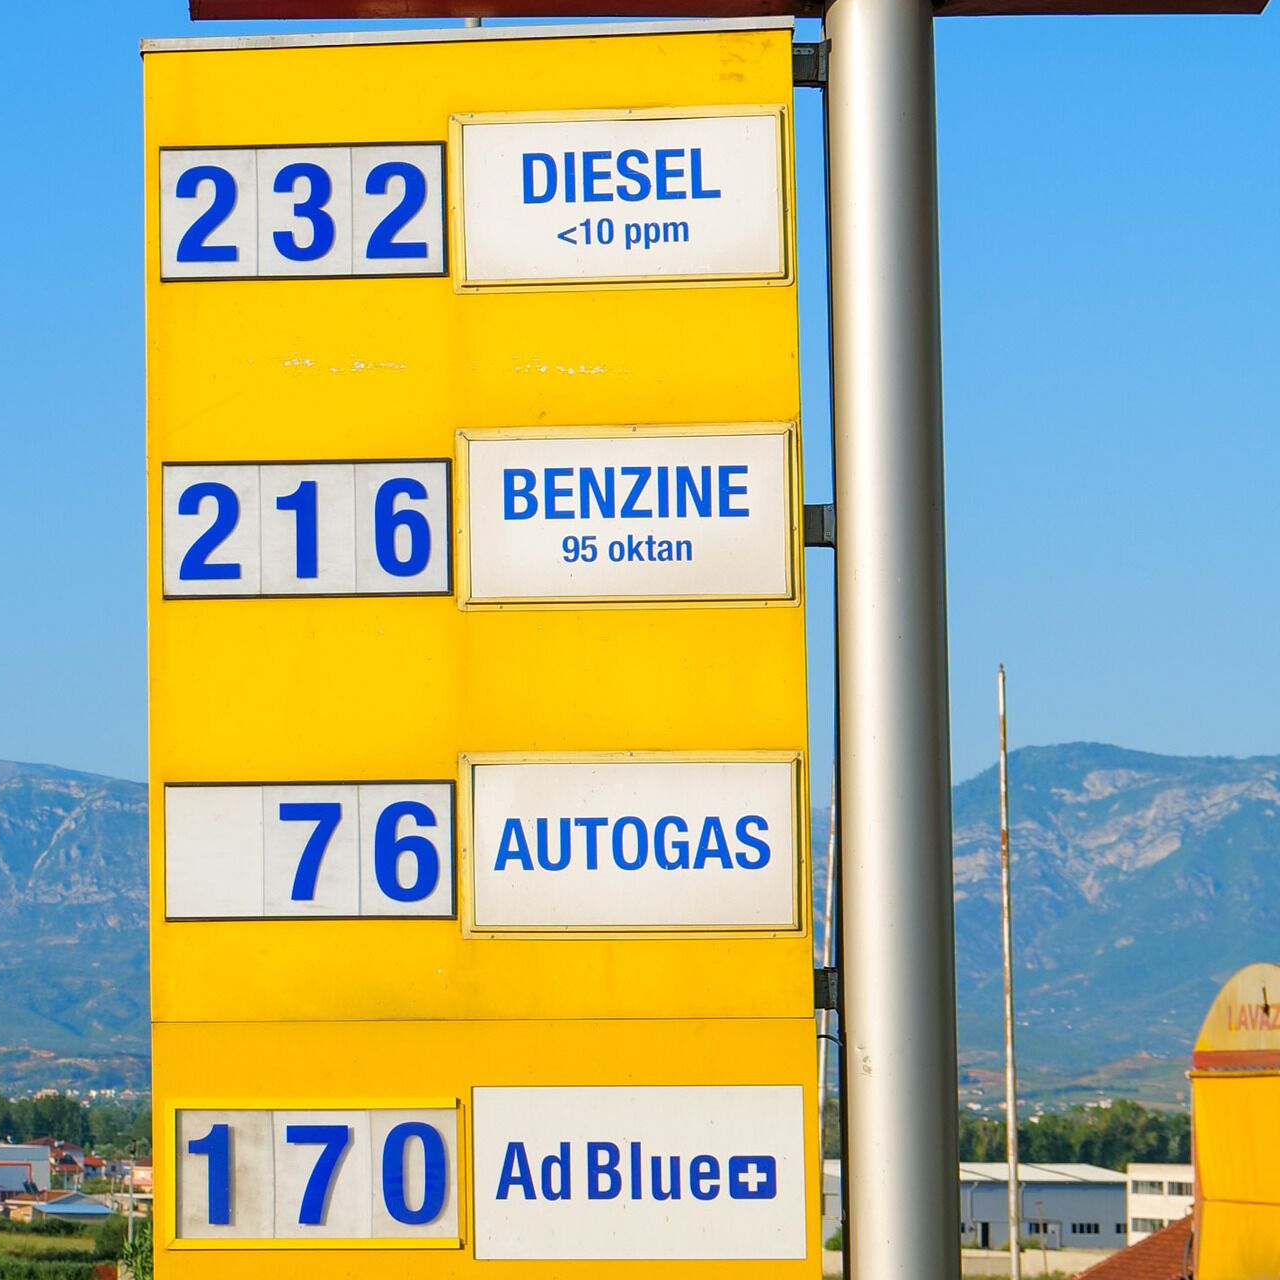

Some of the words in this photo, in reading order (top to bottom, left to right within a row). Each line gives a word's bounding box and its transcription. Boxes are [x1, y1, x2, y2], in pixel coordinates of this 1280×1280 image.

[522, 148, 720, 204] DIESEL
[176, 162, 427, 263] 232
[558, 219, 613, 244] <10
[625, 222, 688, 249] ppm
[503, 465, 749, 519] BENZINE
[178, 478, 430, 581] 216
[562, 536, 597, 562] 95
[608, 535, 691, 562] oktan
[279, 801, 438, 902] 76
[495, 816, 770, 871] AUTOGAS
[188, 1123, 446, 1224] 170
